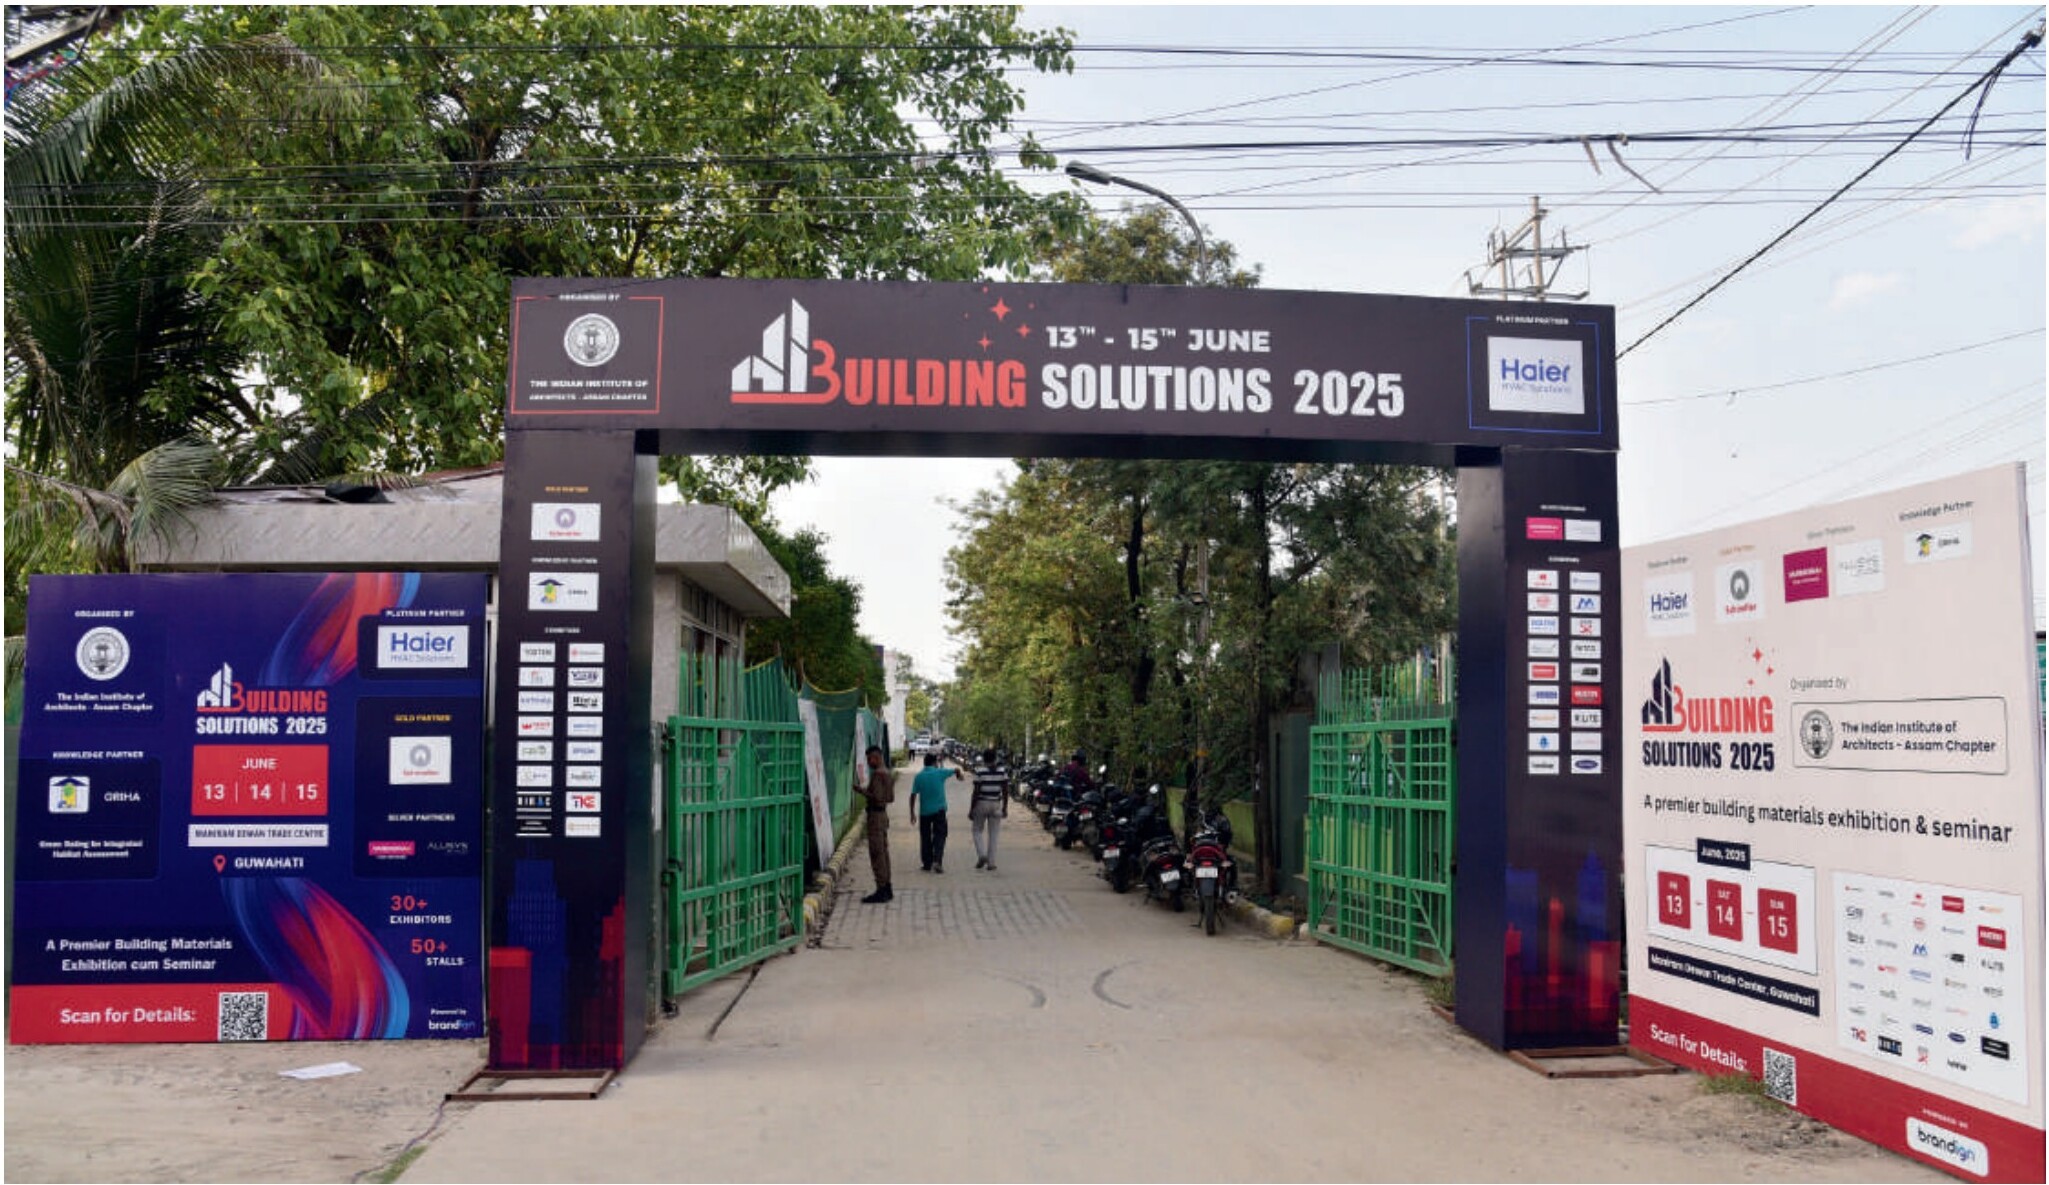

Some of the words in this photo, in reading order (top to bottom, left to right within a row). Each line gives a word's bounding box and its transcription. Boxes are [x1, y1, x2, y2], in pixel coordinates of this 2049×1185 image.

[1188, 329, 1272, 353] JUNE
[811, 339, 1027, 408] BUILDING
[1041, 363, 1273, 412] SOLUTIONS
[1293, 369, 1406, 417] 2025
[1501, 358, 1570, 382] Haier
[1651, 592, 1688, 613] Haier
[391, 632, 454, 652] Haier
[231, 682, 328, 713] BUILDING
[1673, 684, 1774, 733] BUILDING
[196, 716, 279, 735] SOLUTIONS
[286, 716, 327, 735] 2025
[1841, 720, 1858, 733] The
[1861, 720, 1893, 733] Indian
[1896, 720, 1943, 733] Institute
[1945, 720, 1957, 733] of
[1642, 740, 1722, 769] SOLUTIONS
[1730, 741, 1776, 772] 2025
[1841, 739, 1894, 751] Architects
[1904, 740, 1943, 751] Assam
[1945, 739, 1997, 756] Chapter
[241, 758, 278, 770] JUNE
[203, 784, 225, 800] 13
[250, 784, 271, 800] 14
[296, 784, 318, 800] 15
[1643, 794, 1653, 809] A
[1655, 796, 1699, 815] premier
[1702, 797, 1755, 824] building
[1758, 802, 1824, 827] materials
[1828, 809, 1910, 834] exhibition
[1915, 815, 1927, 835] &
[1932, 818, 2012, 844] seminar
[234, 857, 304, 868] GUWAHATI
[390, 895, 428, 911] 30+
[1666, 894, 1683, 915] 13
[390, 915, 452, 924] EXHIBITORS
[1715, 905, 1734, 926] 14
[1767, 915, 1788, 938] 15
[45, 939, 56, 951] A
[60, 939, 110, 951] Premier
[115, 939, 167, 951] Building
[171, 939, 233, 951] Materials
[411, 938, 448, 954] 50+
[62, 958, 127, 971] Exhibition
[131, 958, 158, 971] cum
[162, 958, 216, 971] Seminar
[426, 957, 464, 966] STALLS
[59, 1008, 101, 1023] Scan
[105, 1008, 129, 1023] for
[133, 1008, 195, 1023] Details:
[1651, 1023, 1678, 1047] Scan
[1680, 1033, 1698, 1054] for
